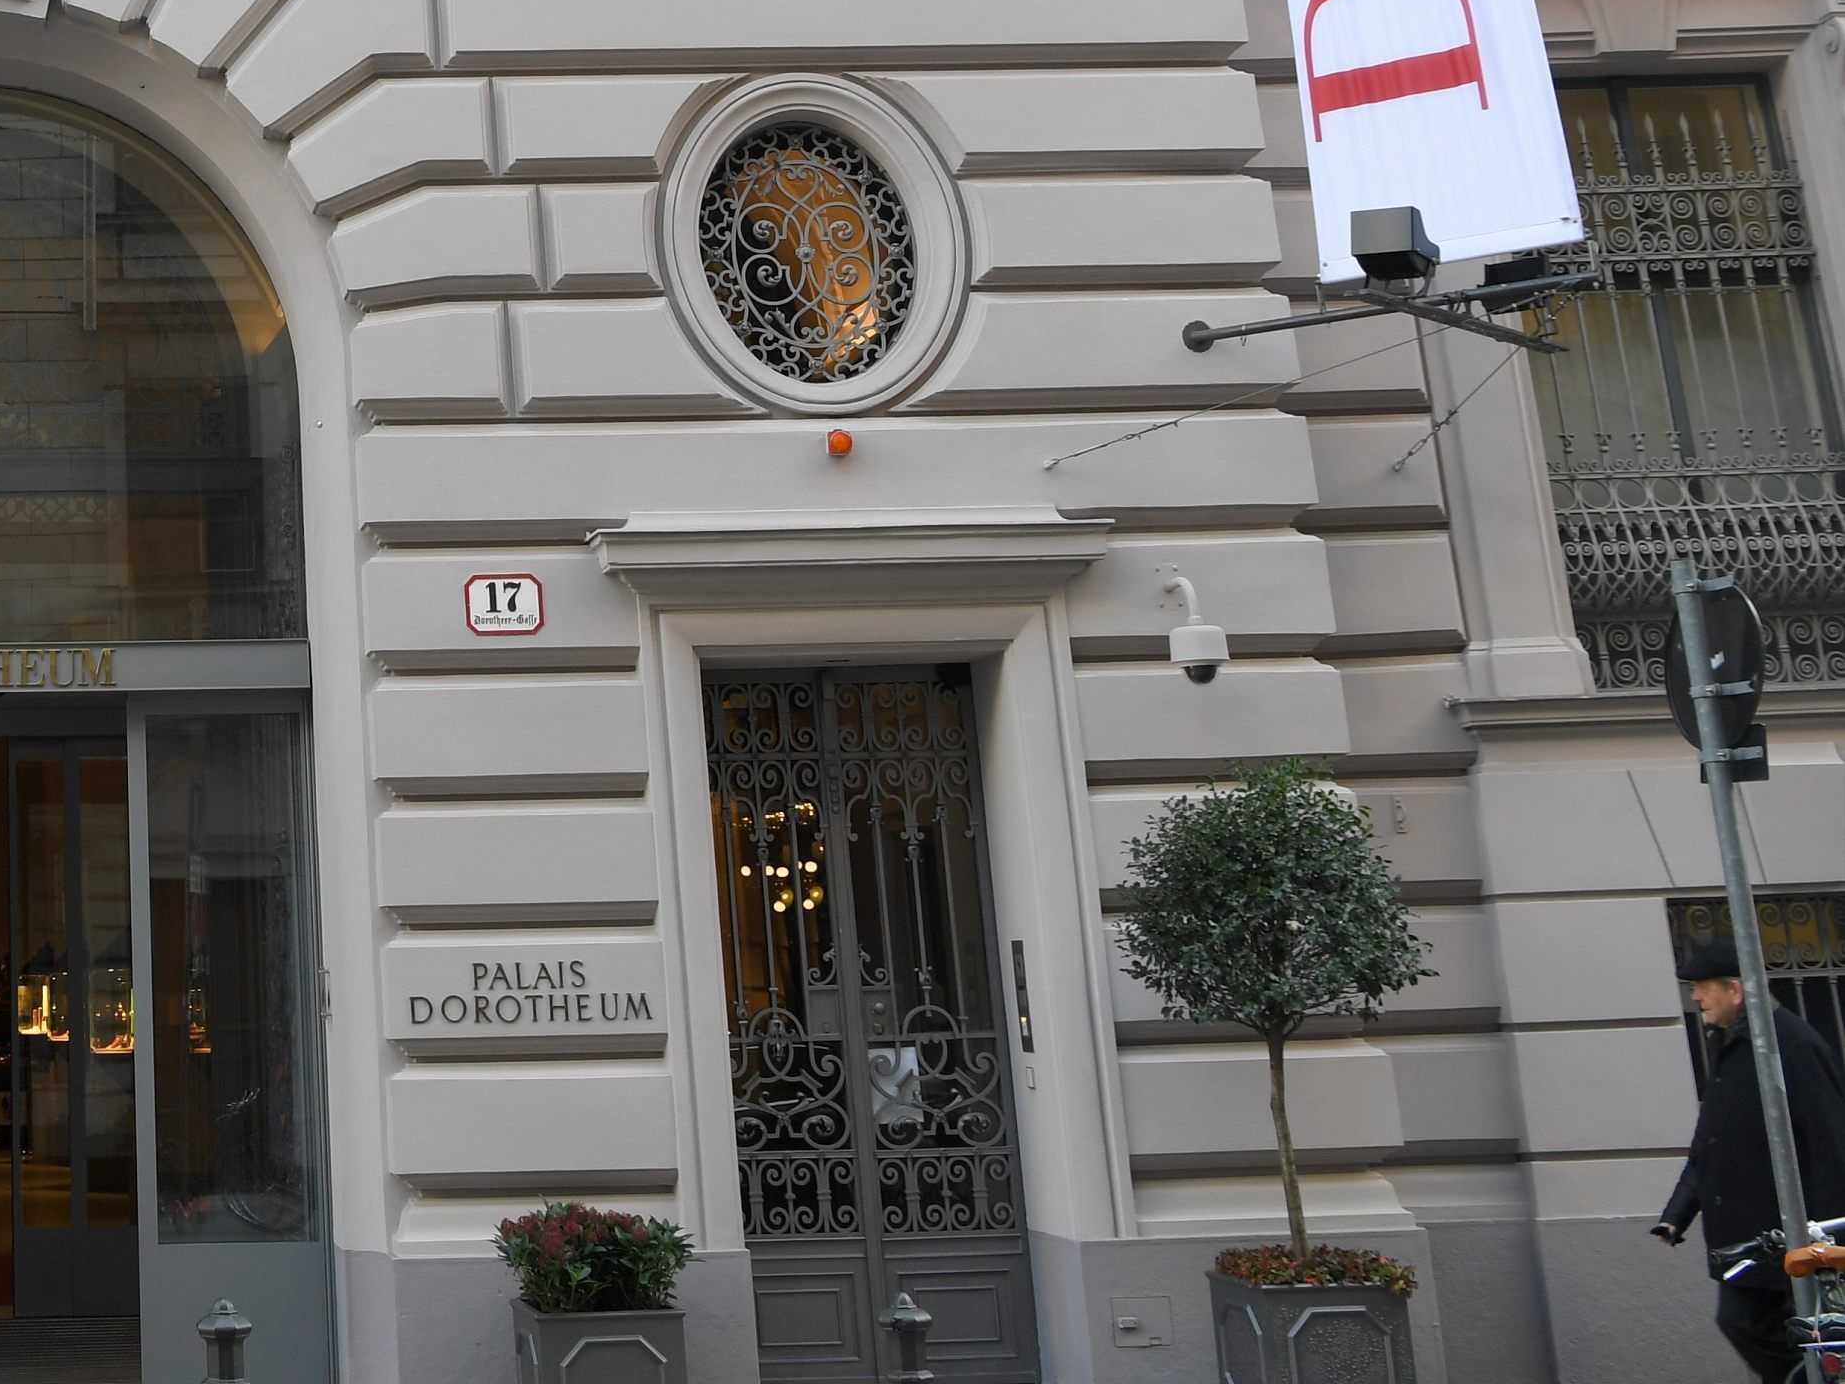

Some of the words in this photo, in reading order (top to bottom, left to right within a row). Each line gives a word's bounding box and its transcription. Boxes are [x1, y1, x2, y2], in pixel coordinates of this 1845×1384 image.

[485, 581, 522, 613] 17
[471, 960, 586, 990] PALAIS
[409, 992, 653, 1024] DOROTHEUM
